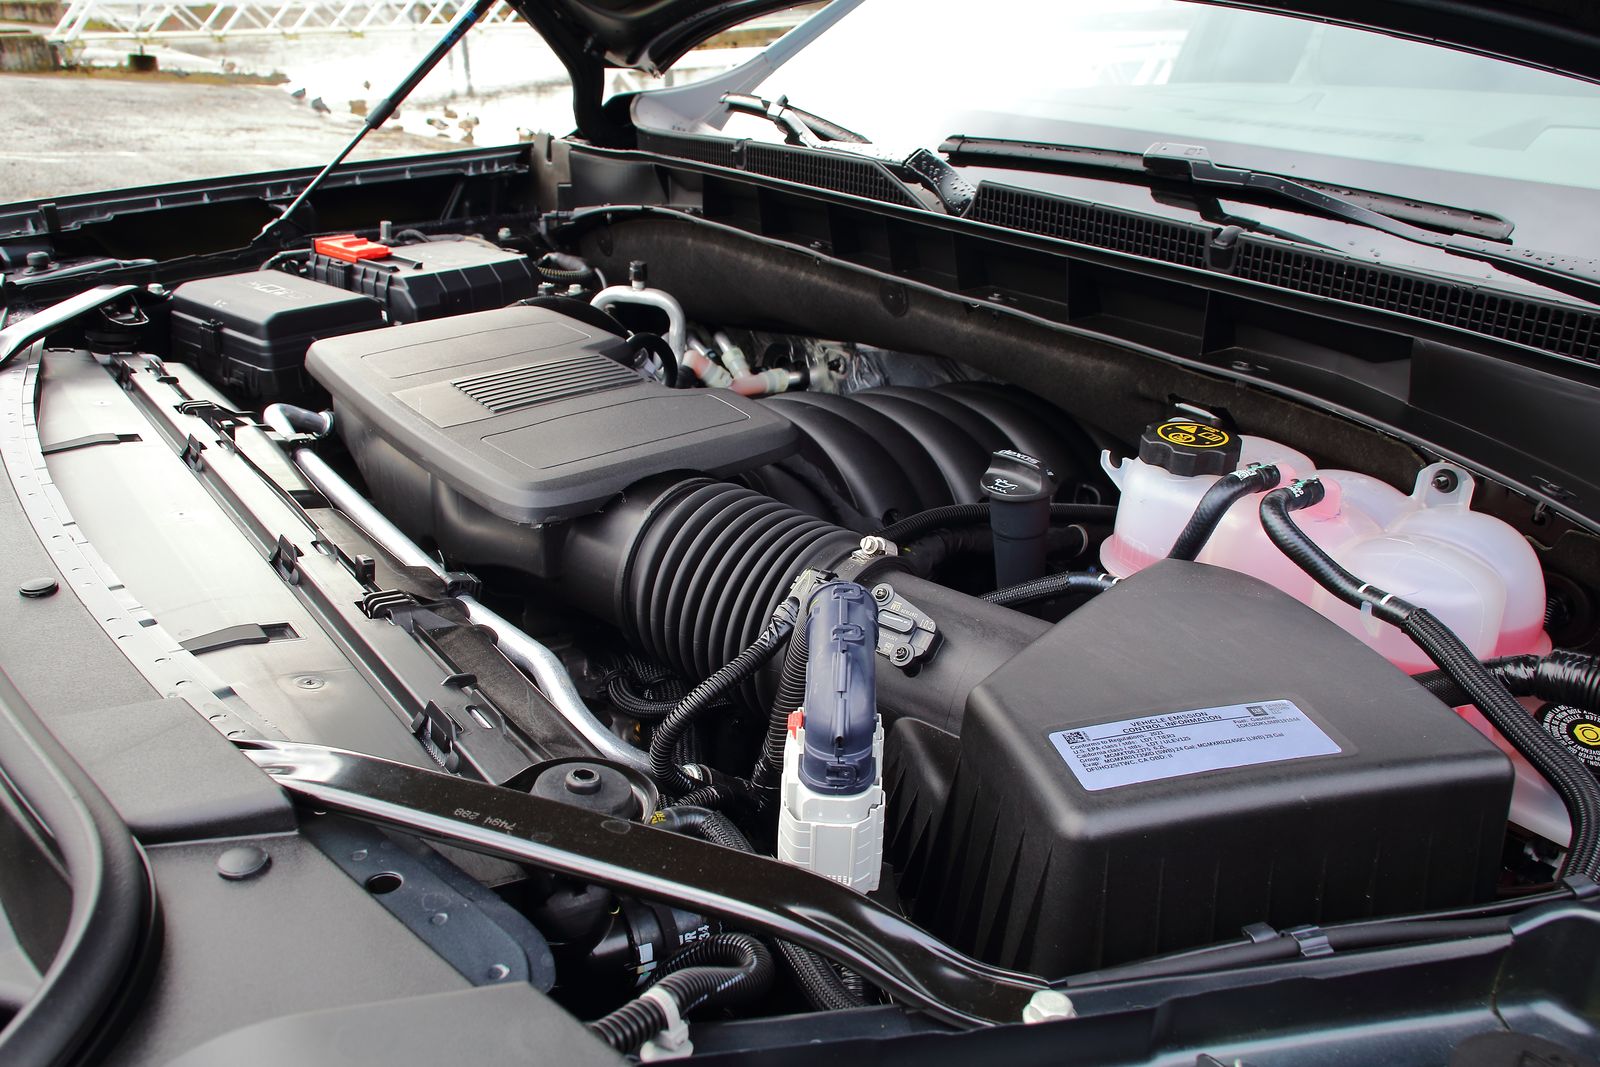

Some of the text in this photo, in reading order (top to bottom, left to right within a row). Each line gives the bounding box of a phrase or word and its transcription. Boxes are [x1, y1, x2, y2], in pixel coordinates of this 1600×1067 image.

[1123, 715, 1221, 733] CONTROL INFORMATION
[1130, 712, 1208, 727] VEHICLE EMISSION
[1070, 740, 1100, 750] Conforms
[1076, 750, 1107, 759] California
